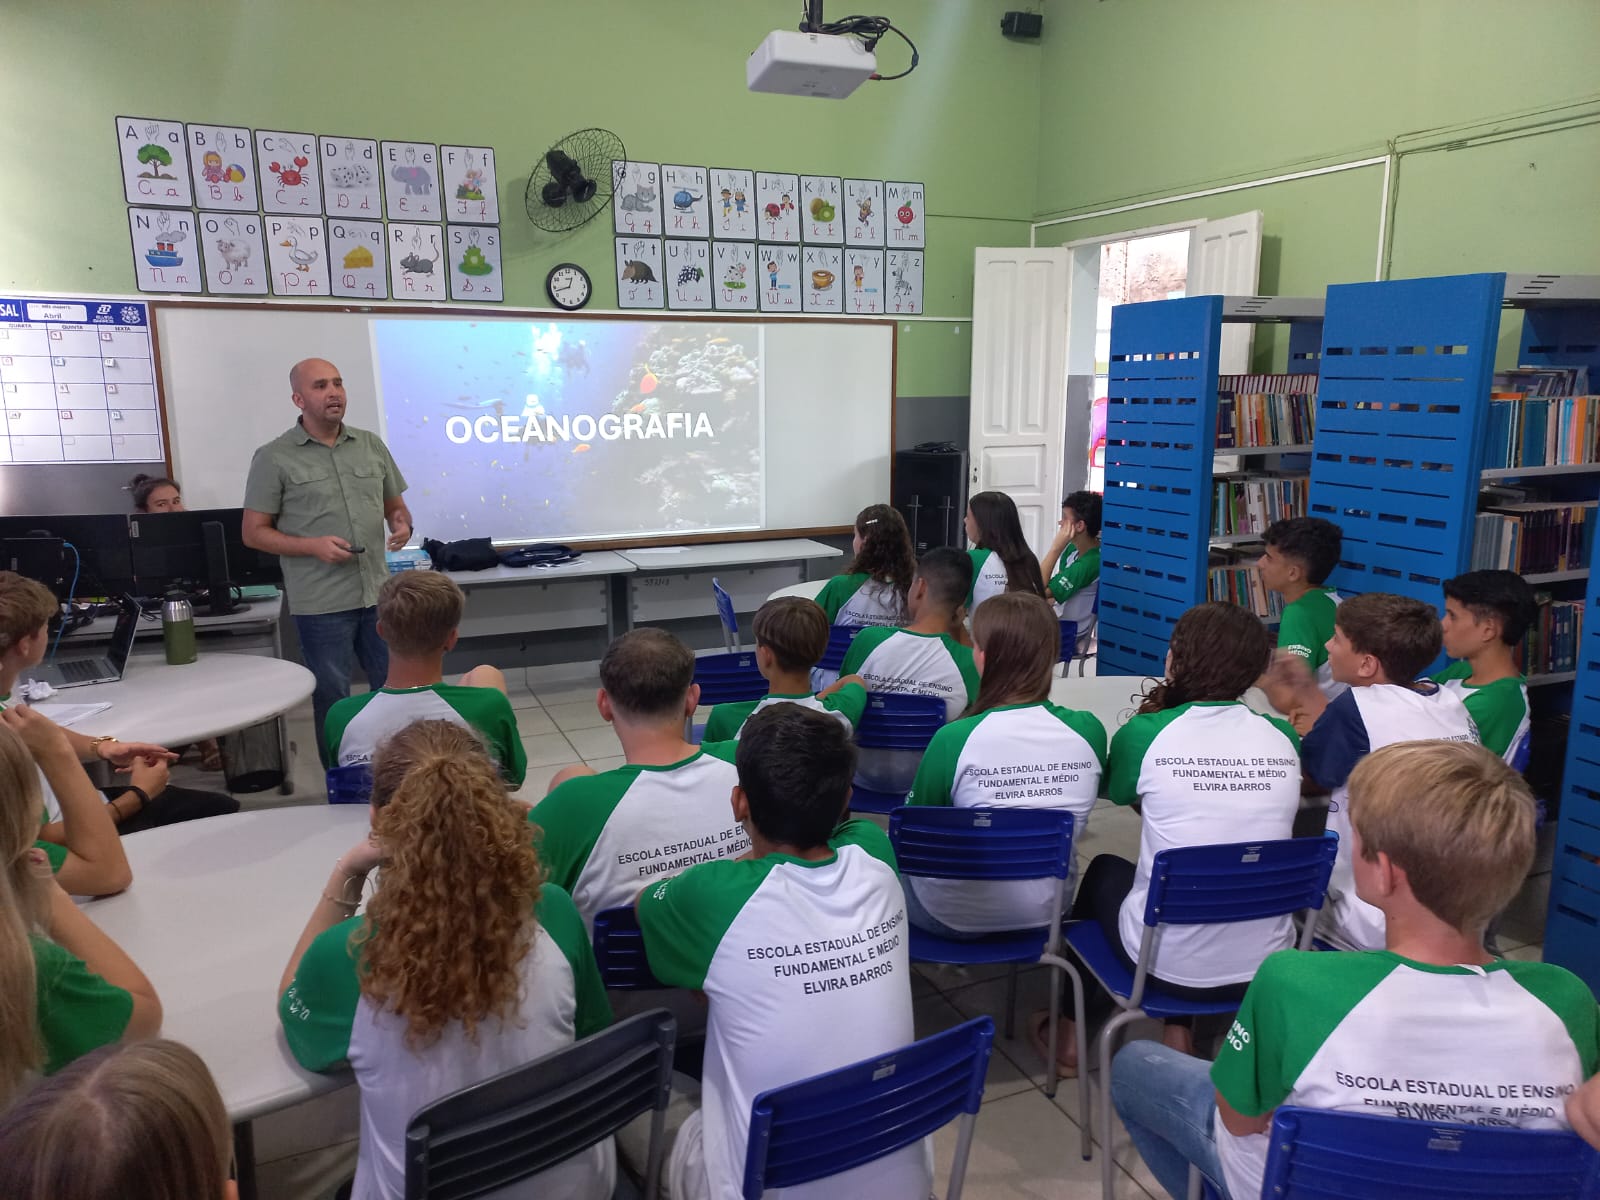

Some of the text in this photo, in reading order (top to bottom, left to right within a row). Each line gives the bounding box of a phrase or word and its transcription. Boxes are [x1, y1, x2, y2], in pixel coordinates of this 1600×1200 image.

[126, 126, 179, 143] A a
[196, 132, 245, 148] B b
[263, 138, 310, 154] C c
[326, 144, 372, 159] D d
[389, 149, 432, 163] E e
[448, 153, 488, 167] F f
[648, 172, 655, 184] g
[667, 172, 703, 184] H h
[744, 176, 748, 187] i
[762, 178, 768, 190] J
[166, 188, 179, 196] a
[208, 185, 223, 200] B
[805, 182, 837, 193] K k
[849, 185, 854, 197] L
[889, 188, 922, 199] M m
[276, 190, 287, 204] C
[337, 194, 370, 209] D d
[400, 198, 409, 211] E
[137, 215, 188, 231] N n
[206, 220, 256, 234] O o
[674, 216, 700, 229] H h
[273, 223, 319, 240] P p
[334, 226, 380, 244] Q q
[395, 230, 435, 243] R r
[454, 232, 495, 245] S s
[621, 243, 656, 255] T t
[670, 246, 704, 257] U u
[717, 248, 751, 259] V v
[761, 251, 797, 262] W w
[807, 253, 838, 264] X x
[849, 254, 879, 268] Y y
[890, 255, 919, 267] Z z
[219, 271, 232, 284] O
[281, 273, 318, 293] P p
[365, 283, 375, 296] q
[403, 278, 415, 291] R
[445, 412, 714, 444] OCEANOGRAFIA
[929, 682, 952, 692] ENSINO
[1155, 757, 1195, 766] ESCOLA
[1197, 758, 1249, 766] ESTADUAL
[964, 761, 1092, 776] ESCOLA ESTADUAL DE ENSINO
[1173, 768, 1287, 779] FUNDAMENTAL E MÉDIO
[978, 777, 1041, 788] FUNDAMENTAL
[1052, 774, 1079, 783] MÉDIO
[1193, 783, 1271, 791] ELVIRA BARROS
[995, 788, 1063, 800] ELVIRA BARROS
[618, 848, 662, 865] ESCOLA
[664, 835, 718, 856] ESTADUAL
[720, 829, 733, 841] DE
[639, 852, 715, 876] FUNDAMENTAL
[718, 848, 724, 857] E
[747, 910, 903, 959] ESCOLA ESTADUAL DE ENSINO
[774, 934, 900, 977] FUNDAMENTAL E MÉDIO
[804, 961, 893, 994] ELVIRA BARROS
[1336, 1071, 1574, 1099] ESCOLA ESTADUAL DE ENSINO
[1490, 1107, 1501, 1115] E
[1506, 1104, 1555, 1118] MÉDIO
